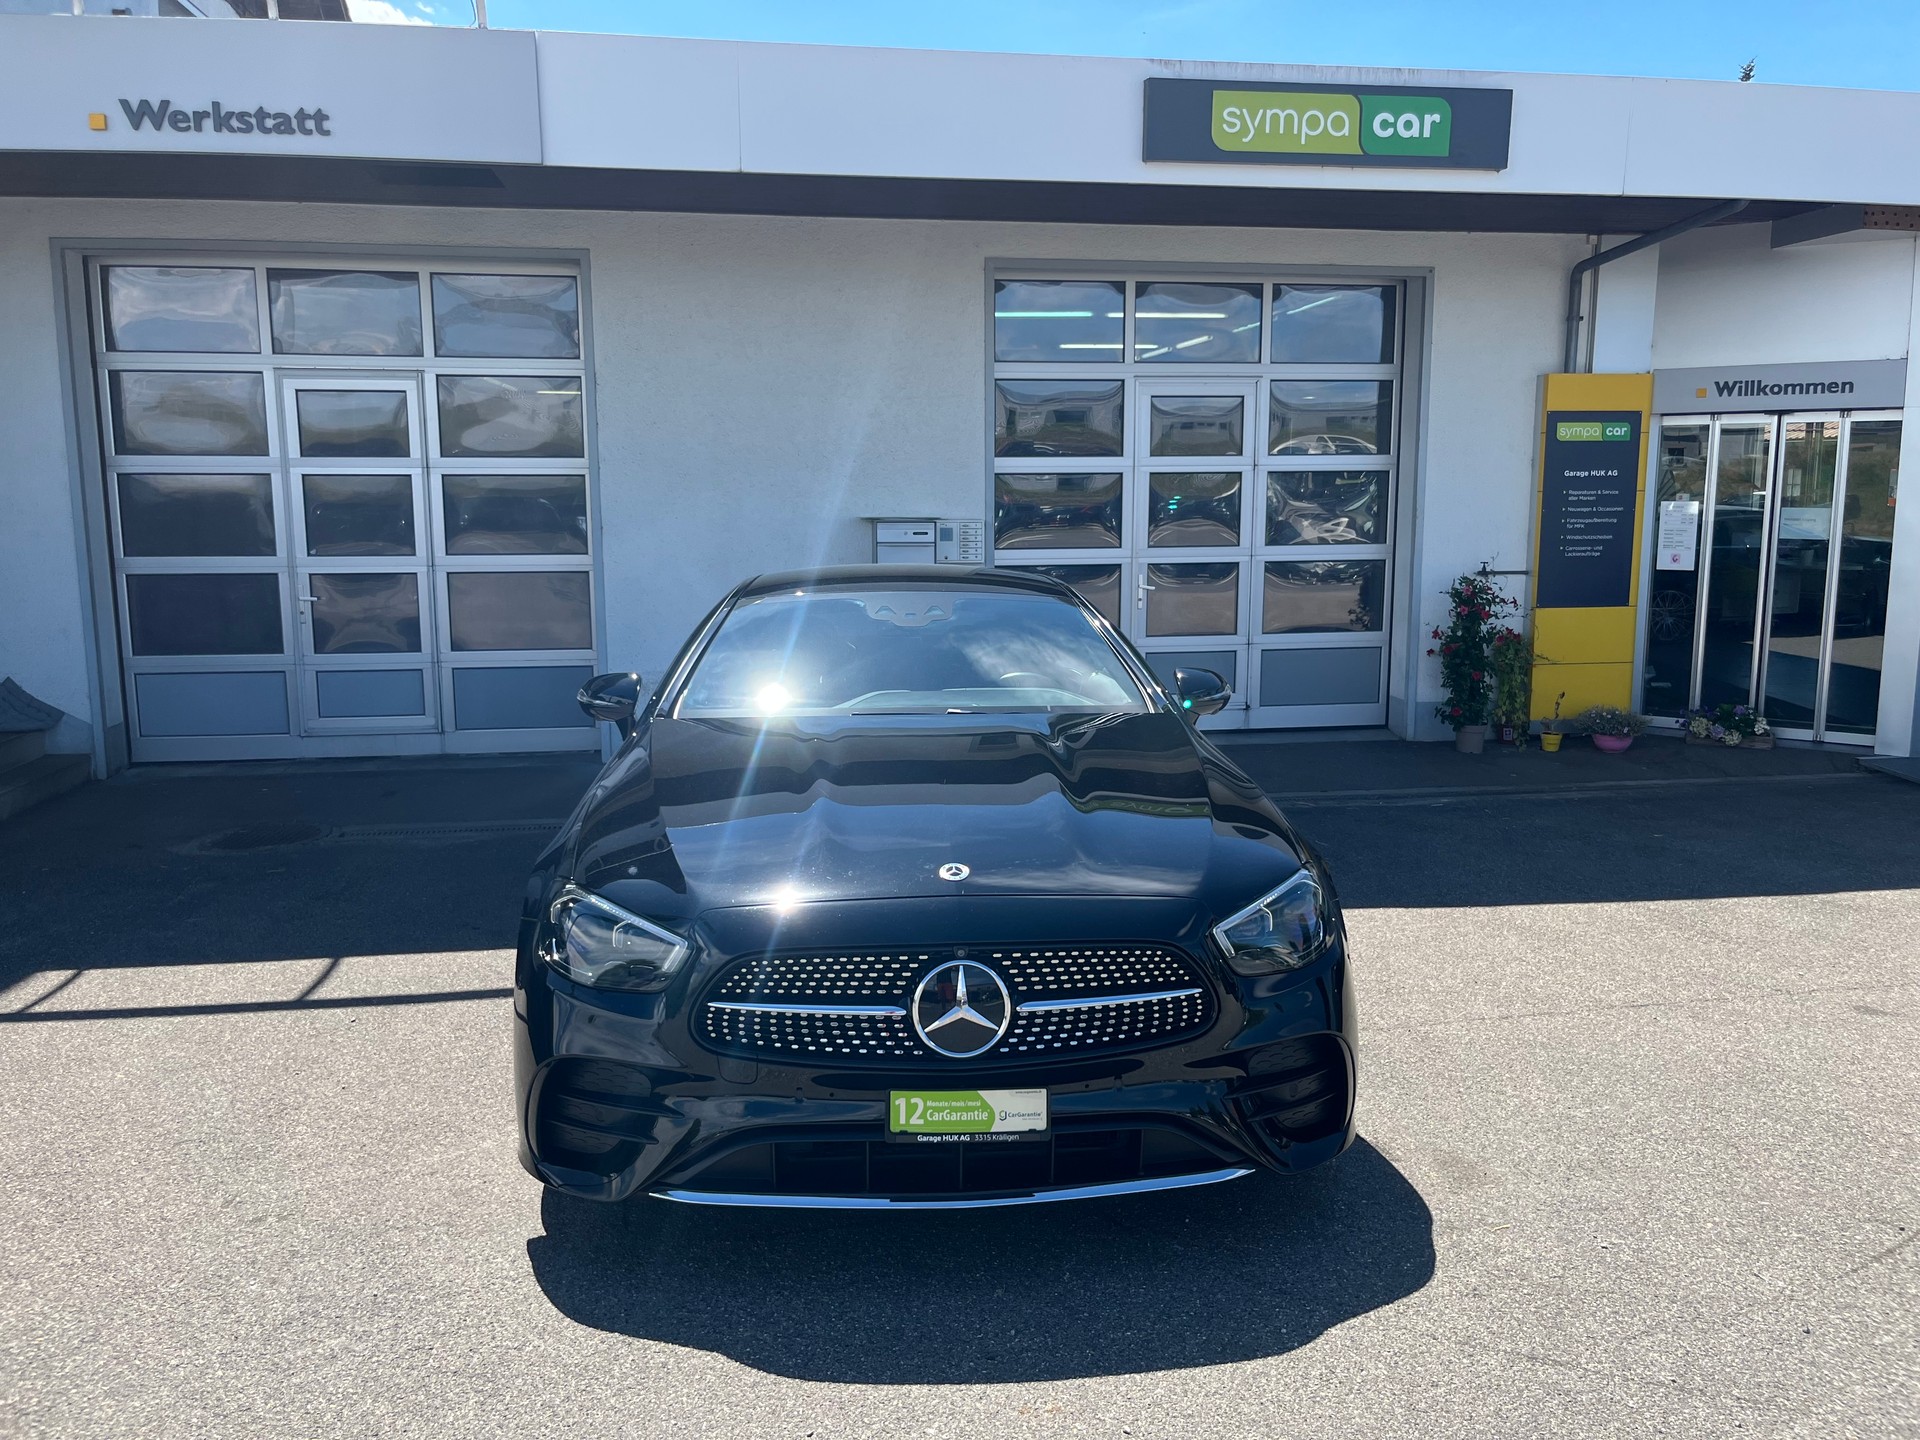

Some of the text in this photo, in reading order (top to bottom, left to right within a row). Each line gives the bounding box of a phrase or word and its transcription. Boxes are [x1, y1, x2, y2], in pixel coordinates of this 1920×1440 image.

[118, 98, 331, 136] Werkstatt
[1222, 107, 1441, 145] sympa car
[1714, 379, 1854, 398] Willkommen
[1559, 427, 1628, 439] sympa car
[1564, 470, 1589, 478] Garage
[895, 1097, 924, 1125] 12
[917, 1134, 942, 1142] Garage
